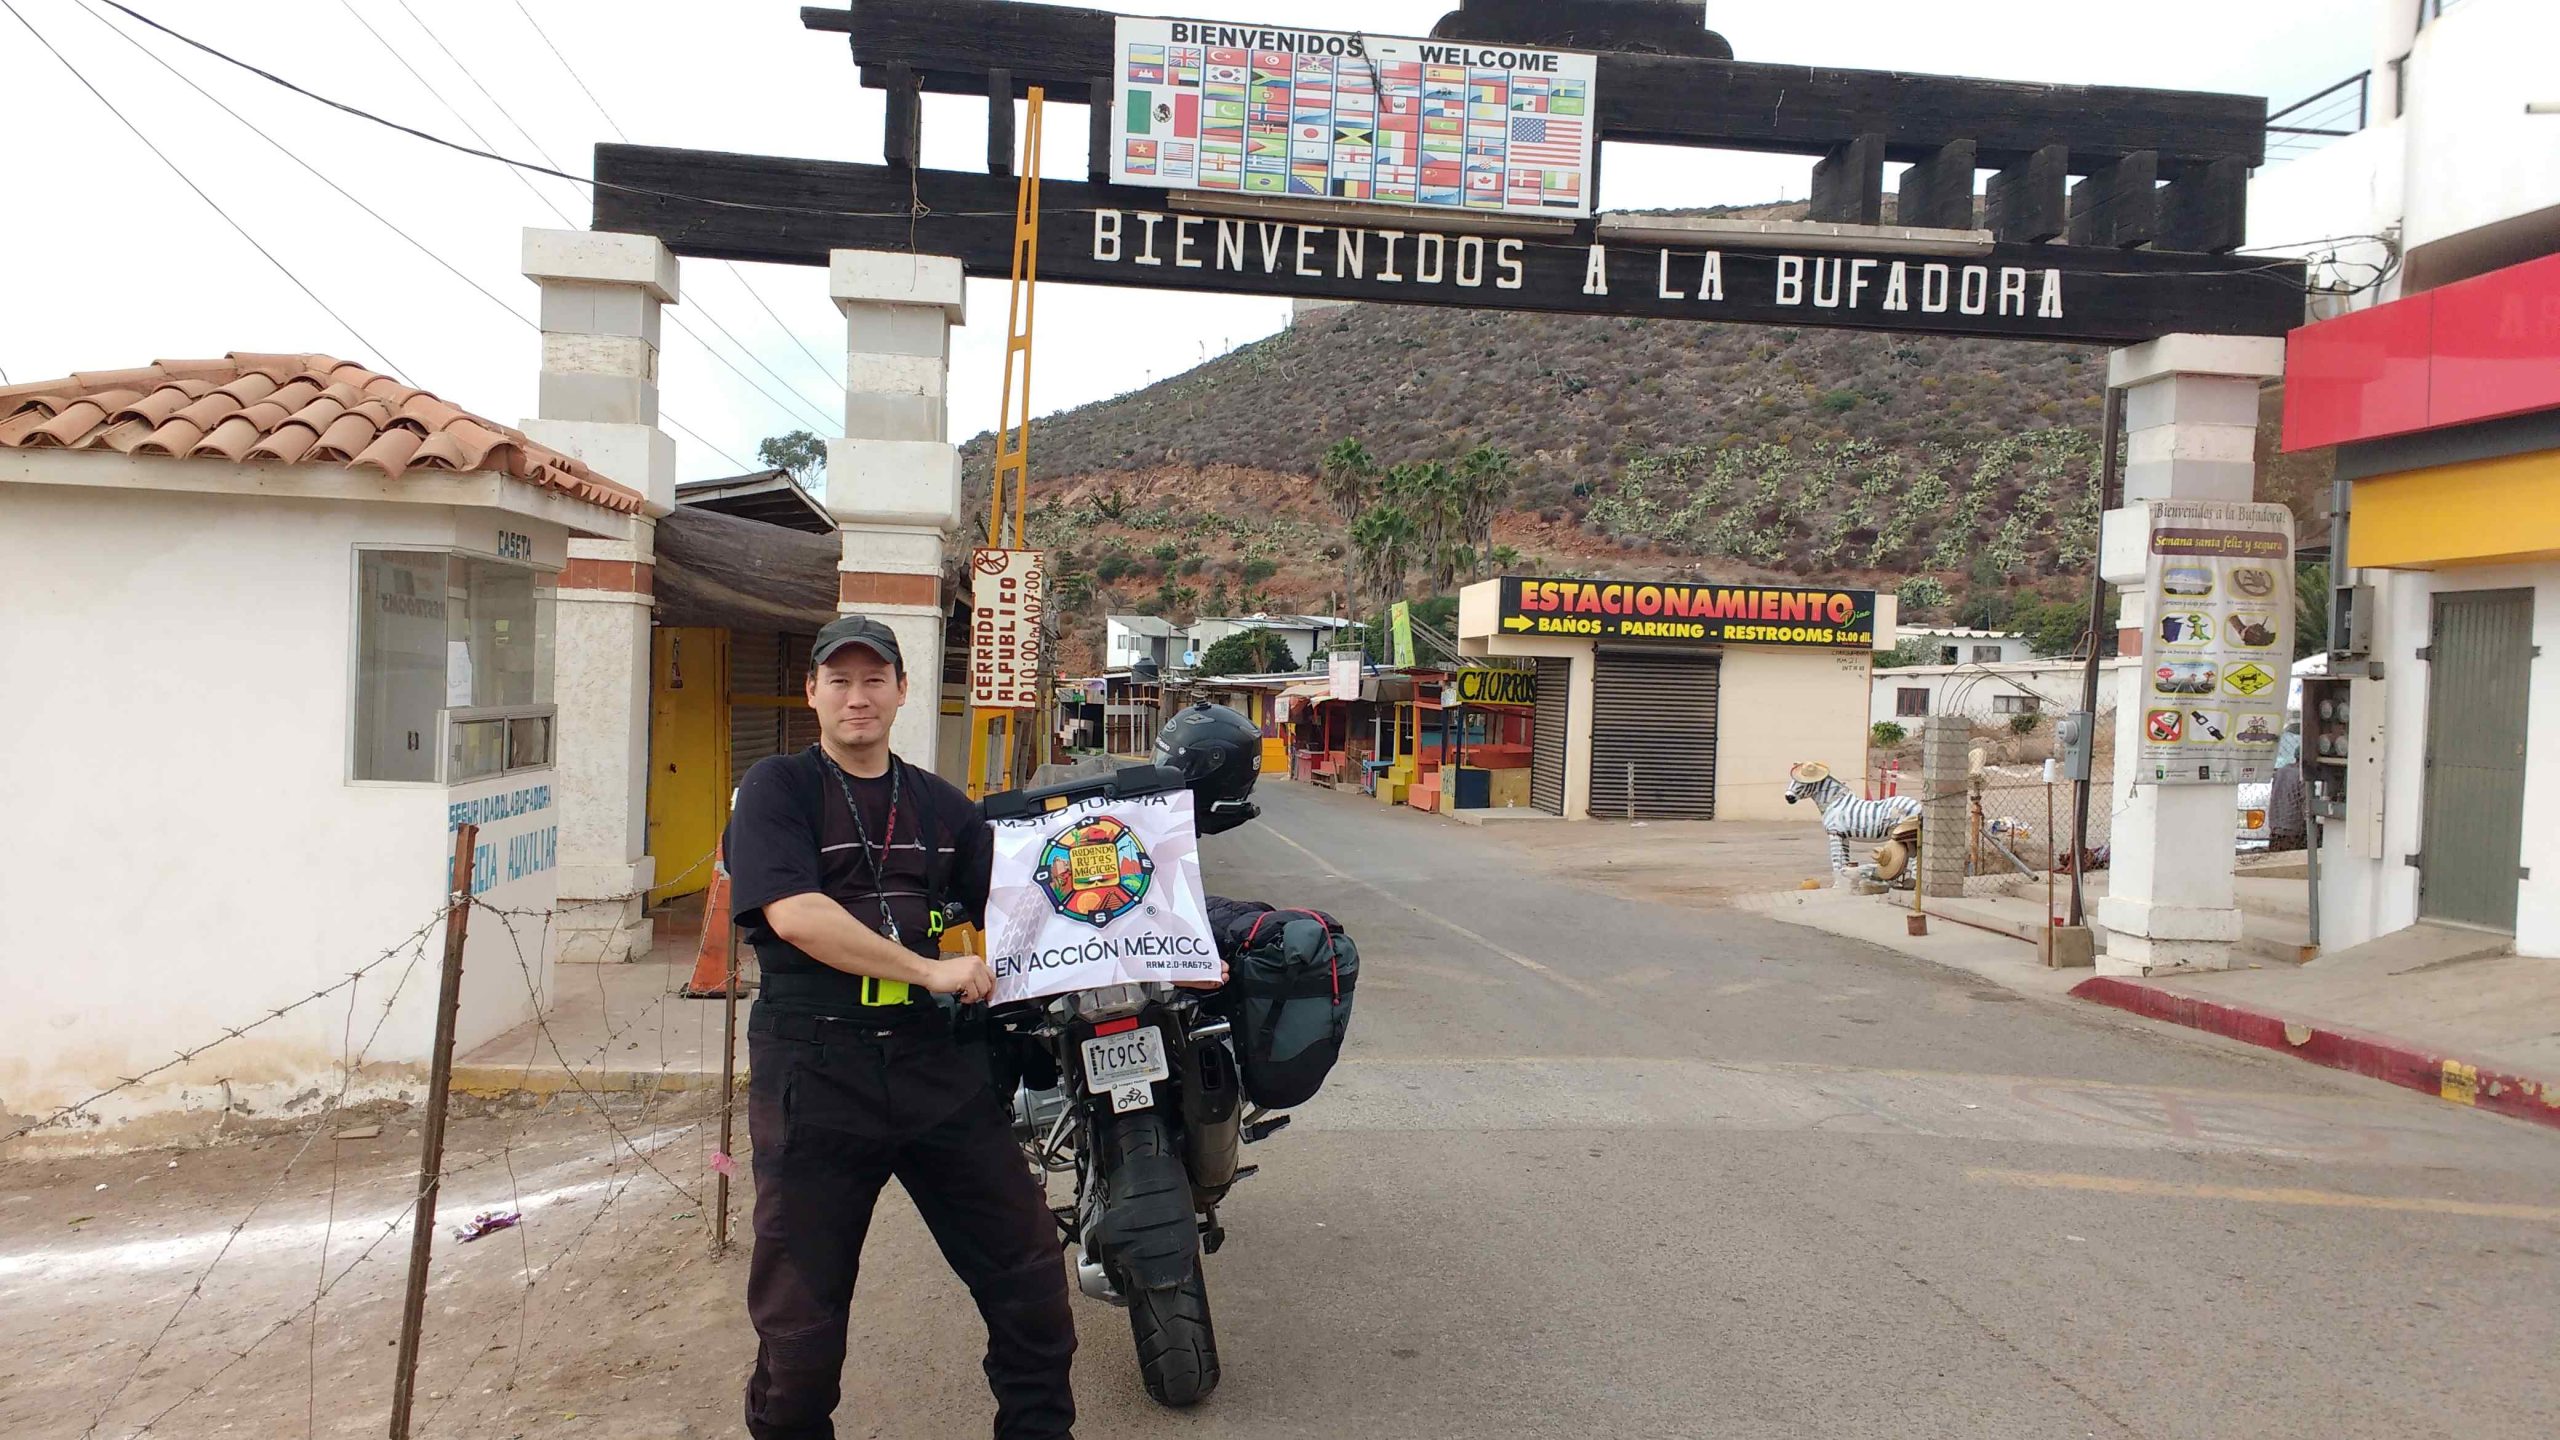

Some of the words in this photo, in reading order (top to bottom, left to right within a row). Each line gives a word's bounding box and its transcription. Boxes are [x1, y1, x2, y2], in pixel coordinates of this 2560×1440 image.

[1171, 23, 1363, 57] BIENVENIDOS
[1419, 45, 1558, 72] WELCOME
[1093, 208, 1524, 289] BIENVENIDOS
[1582, 244, 1608, 295] A
[1658, 248, 1724, 301] LA
[1775, 254, 2063, 319] BUFADORA
[2225, 503, 2235, 520] la
[497, 530, 532, 562] CASETA
[2155, 536, 2193, 547] Semana
[2195, 538, 2221, 548] santa
[2218, 535, 2243, 553] feliz
[2245, 541, 2251, 553] y
[2254, 542, 2283, 554] segura
[1521, 581, 1854, 624] ESTACIONAMIENTO
[1538, 615, 1601, 635] BAÑOS
[1621, 620, 1705, 638] PARKING
[1724, 625, 1833, 643] RESTROOMS
[976, 607, 994, 701] CERRADO
[507, 825, 558, 883] AUXILIAR
[994, 954, 1022, 978] EN
[1028, 937, 1120, 972] ACCIÓN
[1146, 961, 1166, 969] RRM
[1098, 1042, 1148, 1071] 7C9CS
